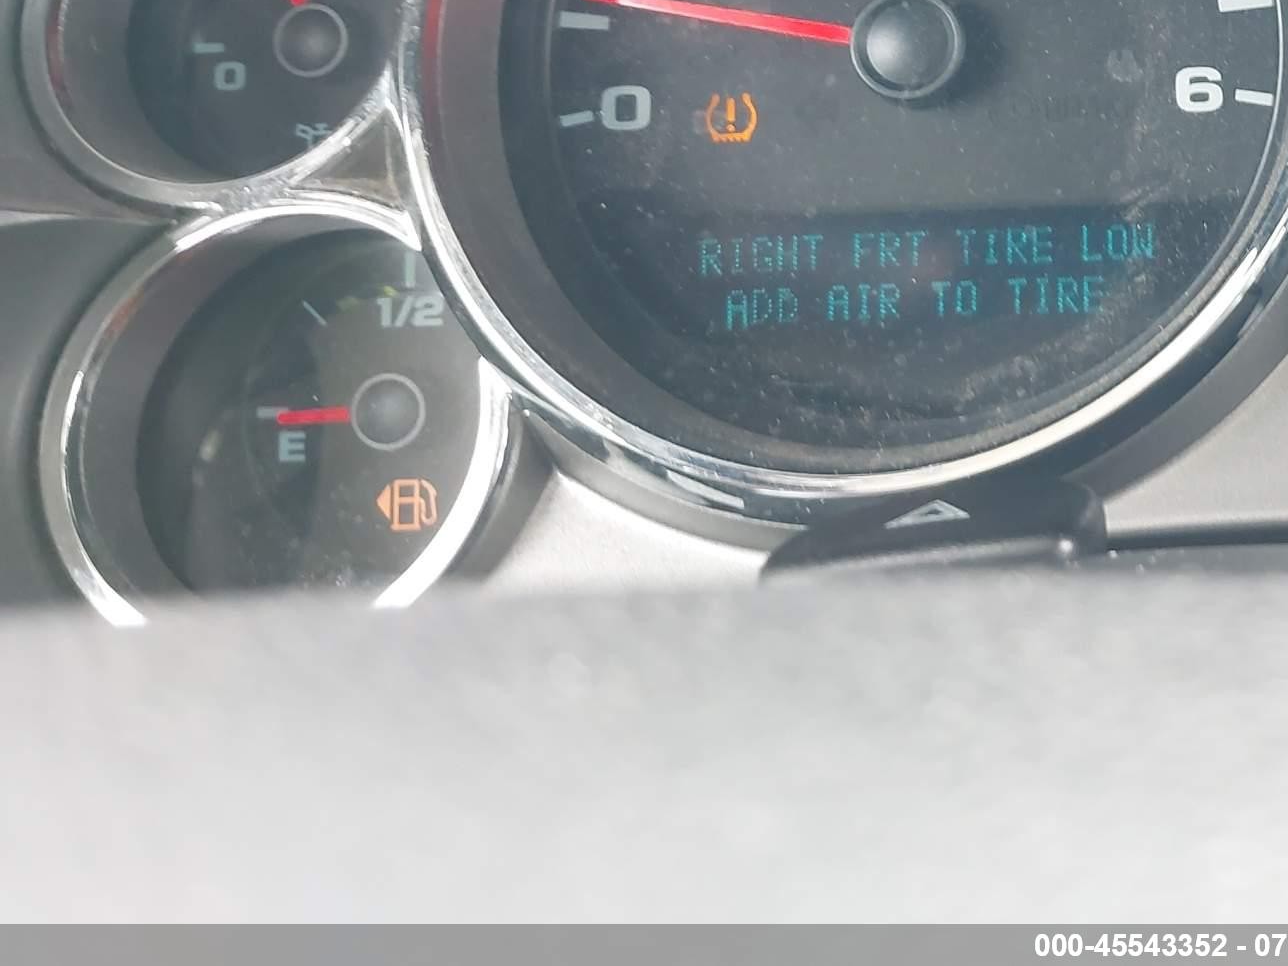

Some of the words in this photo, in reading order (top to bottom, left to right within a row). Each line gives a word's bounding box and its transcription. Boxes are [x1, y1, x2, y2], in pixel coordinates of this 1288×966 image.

[213, 62, 246, 91] 0
[1175, 66, 1224, 113] 6
[602, 85, 652, 131] 0
[700, 235, 825, 277] RIGHT
[852, 231, 929, 269] FRT
[955, 226, 1054, 267] TIRE
[1080, 224, 1156, 264] LOW
[378, 297, 444, 327] 1/2
[726, 288, 800, 331] ADD
[825, 283, 902, 323] AIR
[931, 280, 979, 318] TO
[1008, 276, 1106, 315] TIRE
[278, 431, 306, 462] E
